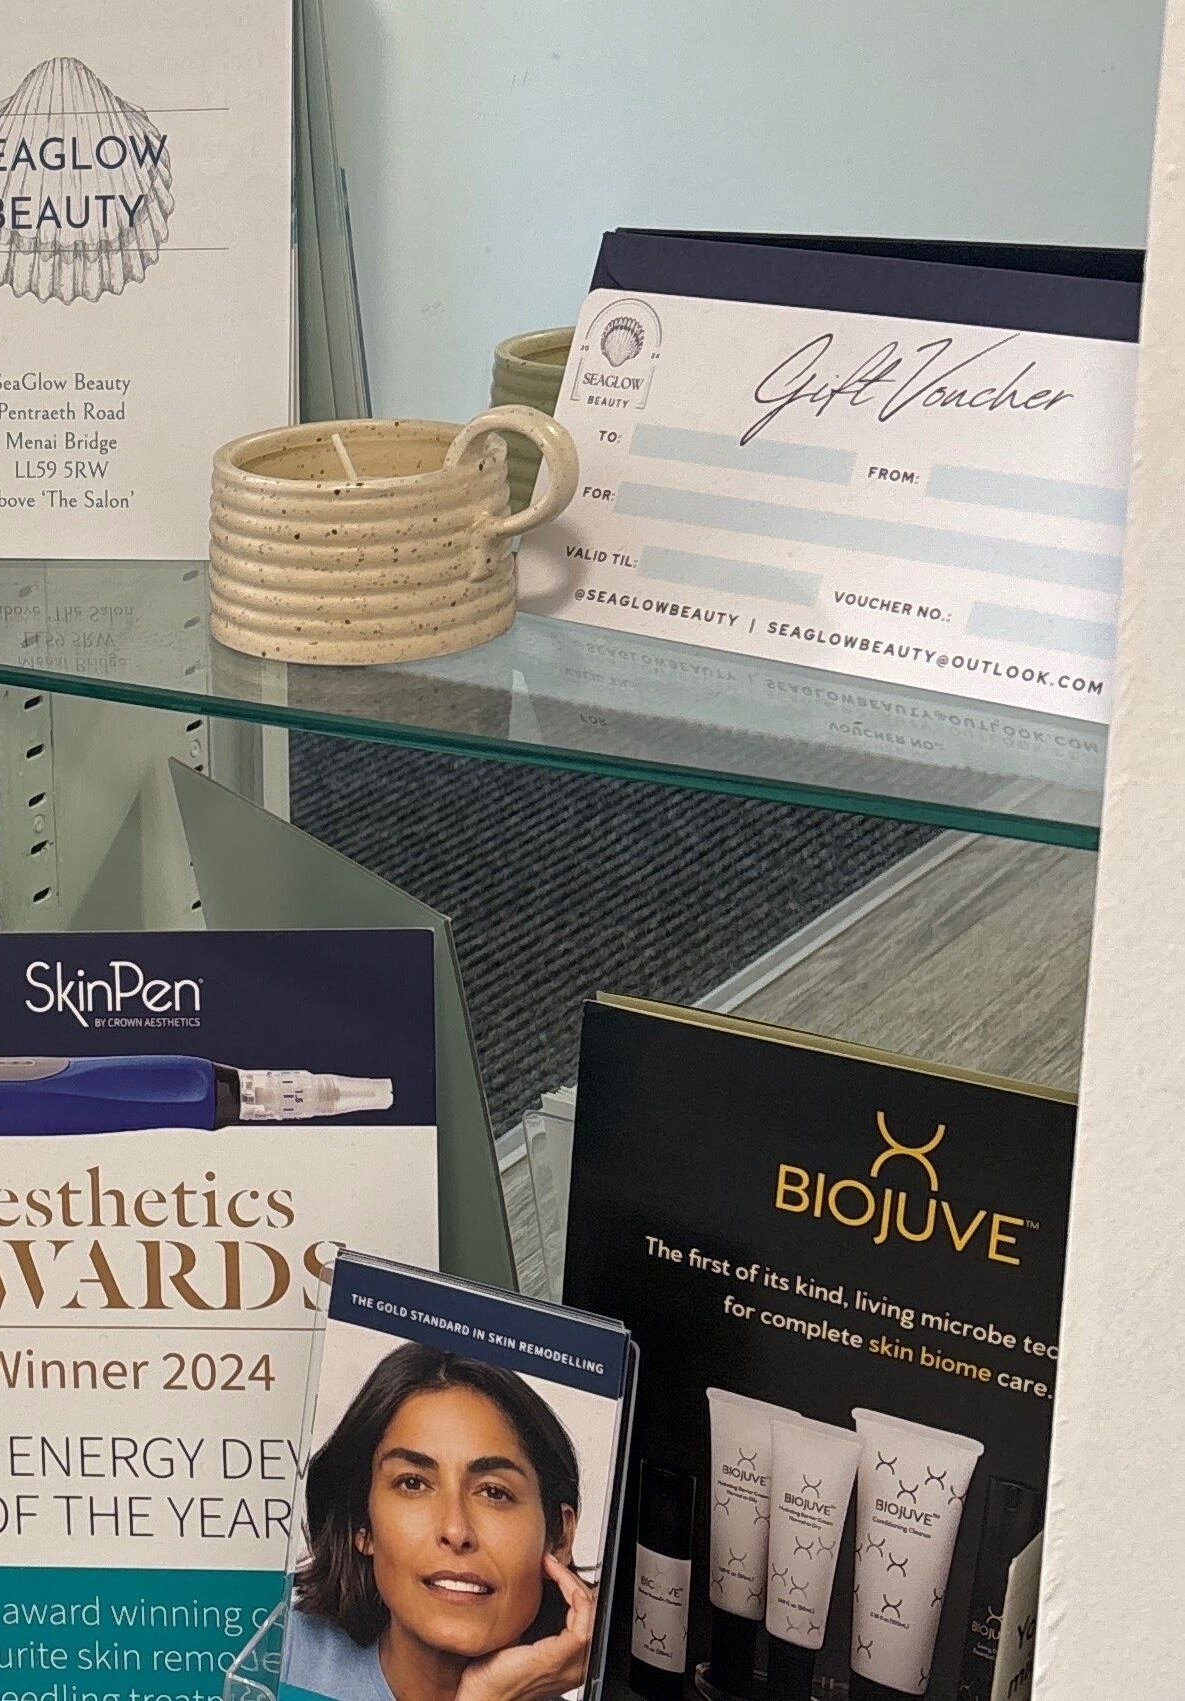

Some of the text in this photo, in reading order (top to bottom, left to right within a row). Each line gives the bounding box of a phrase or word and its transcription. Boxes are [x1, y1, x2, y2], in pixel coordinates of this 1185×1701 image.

[74, 372, 131, 396] Beauty
[582, 372, 645, 391] SEAGLOW
[740, 332, 1074, 446] Gift Voucher
[83, 401, 125, 420] Road
[587, 395, 630, 409] BEAUTY
[6, 431, 118, 455] Menai Bridge
[598, 430, 622, 444] TO:
[15, 460, 109, 479] LL59 5RW
[867, 466, 920, 485] FROM:
[582, 486, 616, 502] FOR:
[565, 545, 608, 563] VALID
[834, 590, 913, 616] VOUCHER
[575, 589, 740, 627] @SEAGLOWBEAUTY
[767, 621, 1105, 696] SEAGLOWBEAUTY@OUTLOOK.COM
[95, 1017, 201, 1028] BY CROWN AESTHETICS
[645, 1236, 683, 1263] The
[689, 1248, 731, 1277] first
[735, 1264, 760, 1283] of
[764, 1267, 790, 1292] its
[795, 1275, 849, 1309] kind,
[855, 1290, 915, 1330] living
[921, 1312, 1017, 1349] microbe
[351, 1293, 605, 1375] THE GOLD STANDARD IN SKIN REMODELLING
[723, 1295, 1053, 1399] for complete skin biome care.
[162, 1352, 275, 1392] 2024
[10, 1436, 205, 1479] ENERGY
[48, 1495, 154, 1538] THE
[167, 1498, 293, 1539] YEAR
[3, 1596, 101, 1626] award
[111, 1599, 243, 1637] winning
[77, 1640, 140, 1670] skin
